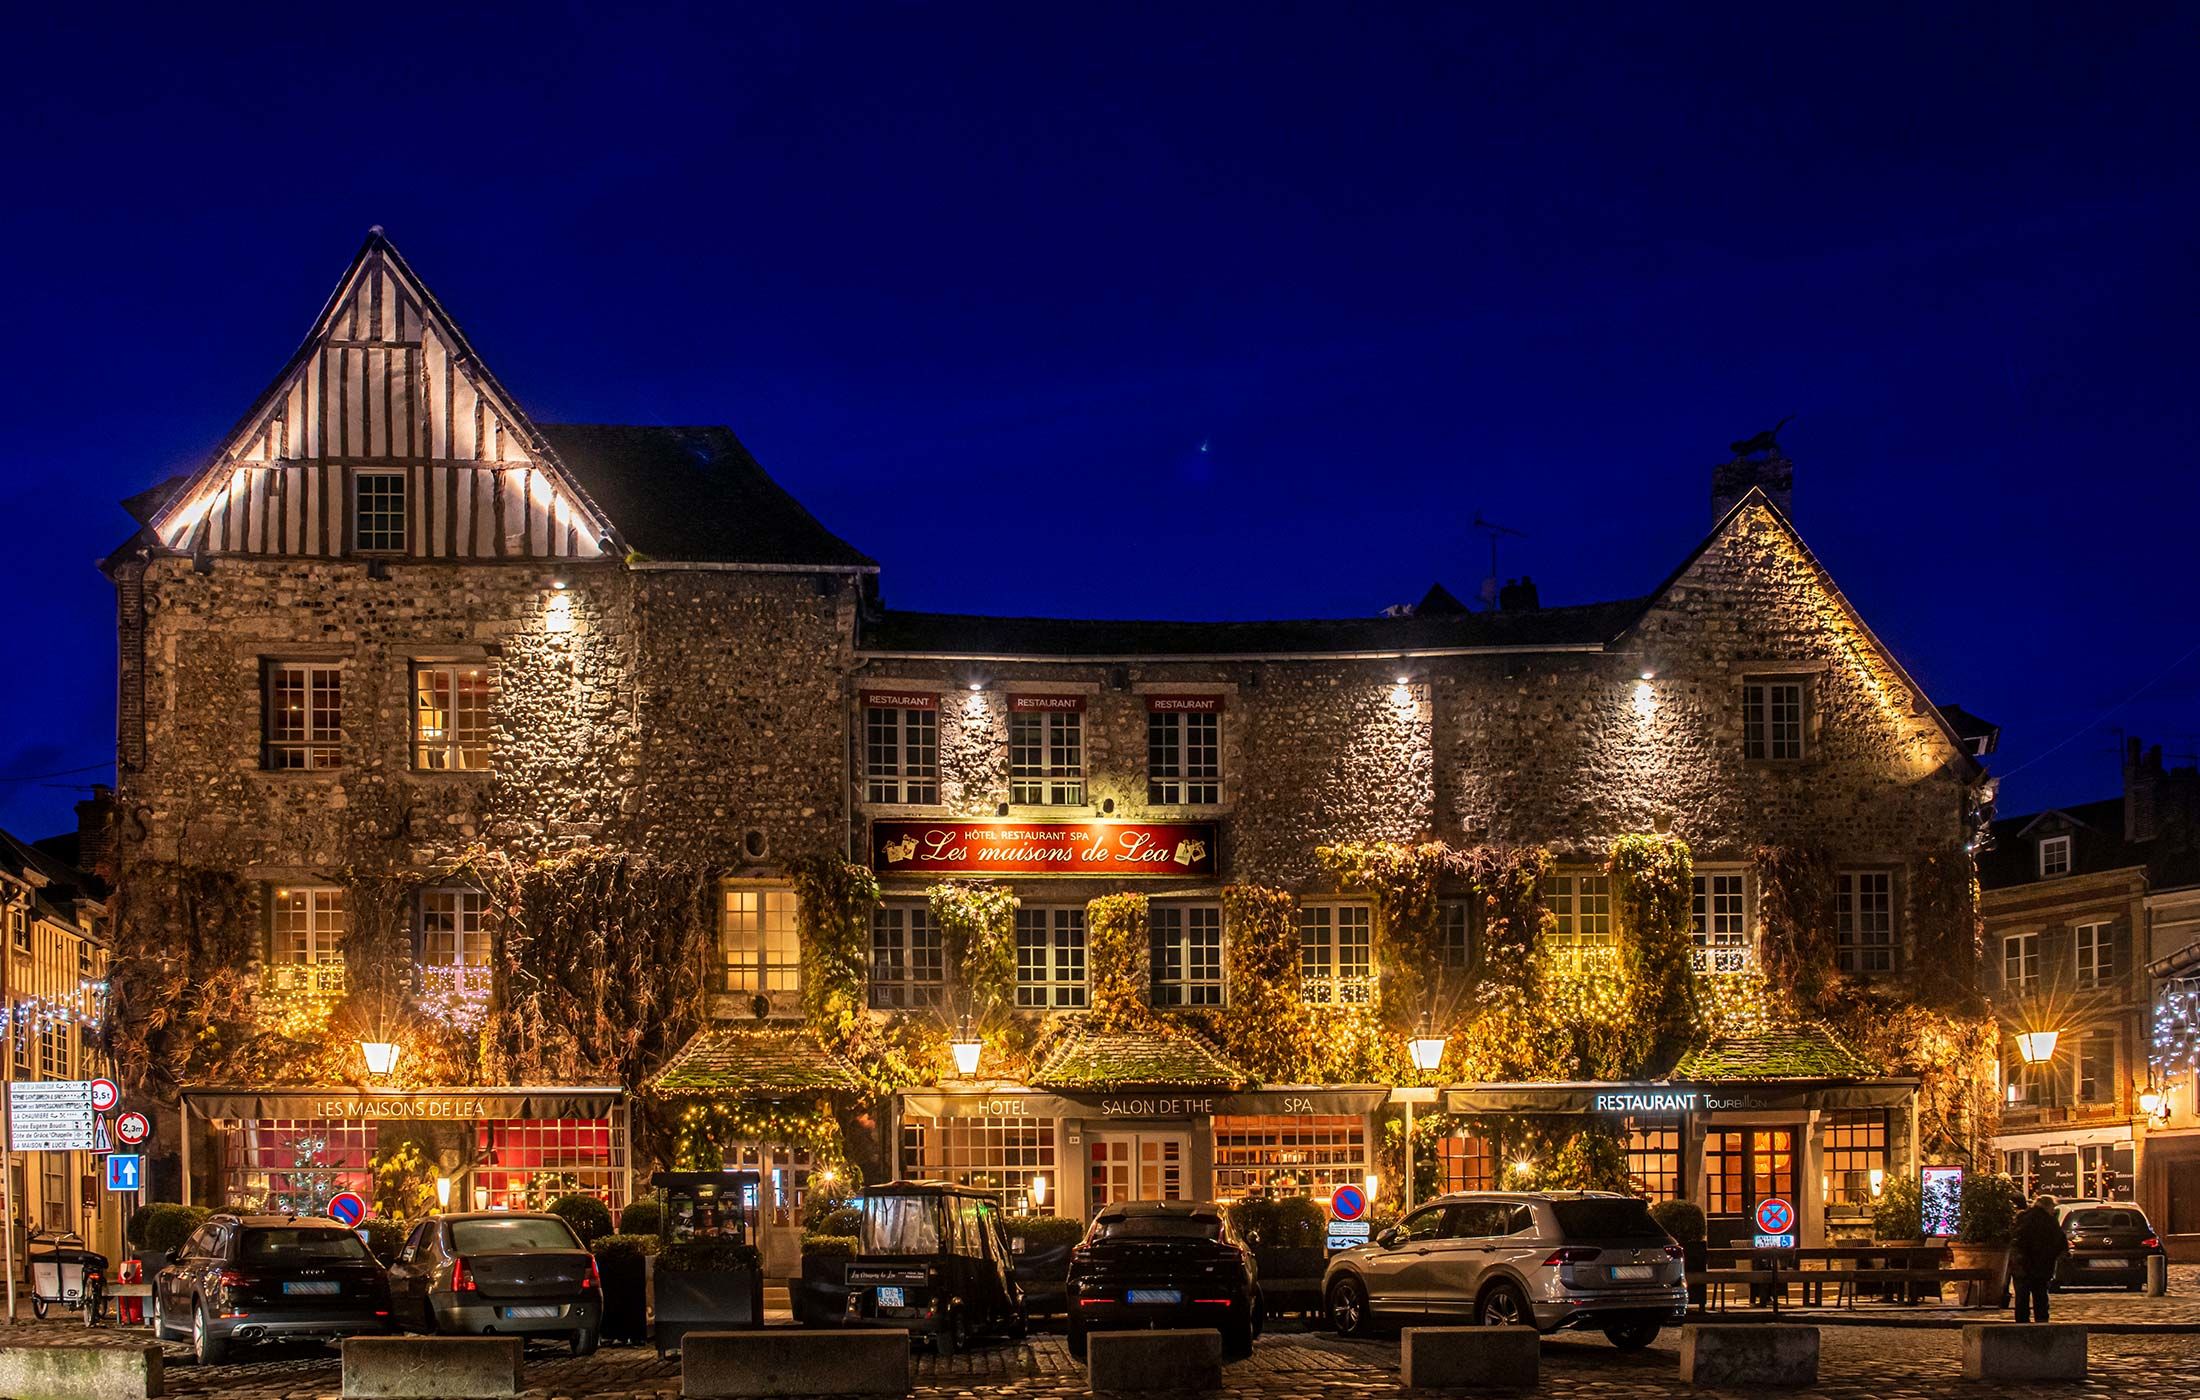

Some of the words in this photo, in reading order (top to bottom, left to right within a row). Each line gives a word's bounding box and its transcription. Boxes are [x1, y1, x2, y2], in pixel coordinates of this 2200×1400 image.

[869, 695, 930, 706] RESTAURANT
[1017, 698, 1077, 708] RESTAURANT
[1154, 699, 1215, 710] RESTAURANT
[964, 829, 997, 841] HÔTEL
[1001, 831, 1066, 841] RESTAURANT
[1070, 831, 1089, 841] SPA
[920, 829, 968, 861] Les
[977, 841, 1073, 861] maisons
[1081, 836, 1109, 861] de
[1114, 830, 1170, 862] Léa
[317, 1102, 344, 1117] LES
[348, 1101, 425, 1117] MAISONS
[429, 1101, 451, 1117] DE
[978, 1100, 1029, 1115] HOTEL
[1102, 1099, 1155, 1115] SALON
[1159, 1099, 1181, 1114] DE
[1183, 1099, 1213, 1113] THE
[1284, 1098, 1313, 1113] SPA
[1597, 1094, 1697, 1111] RESTAURANT
